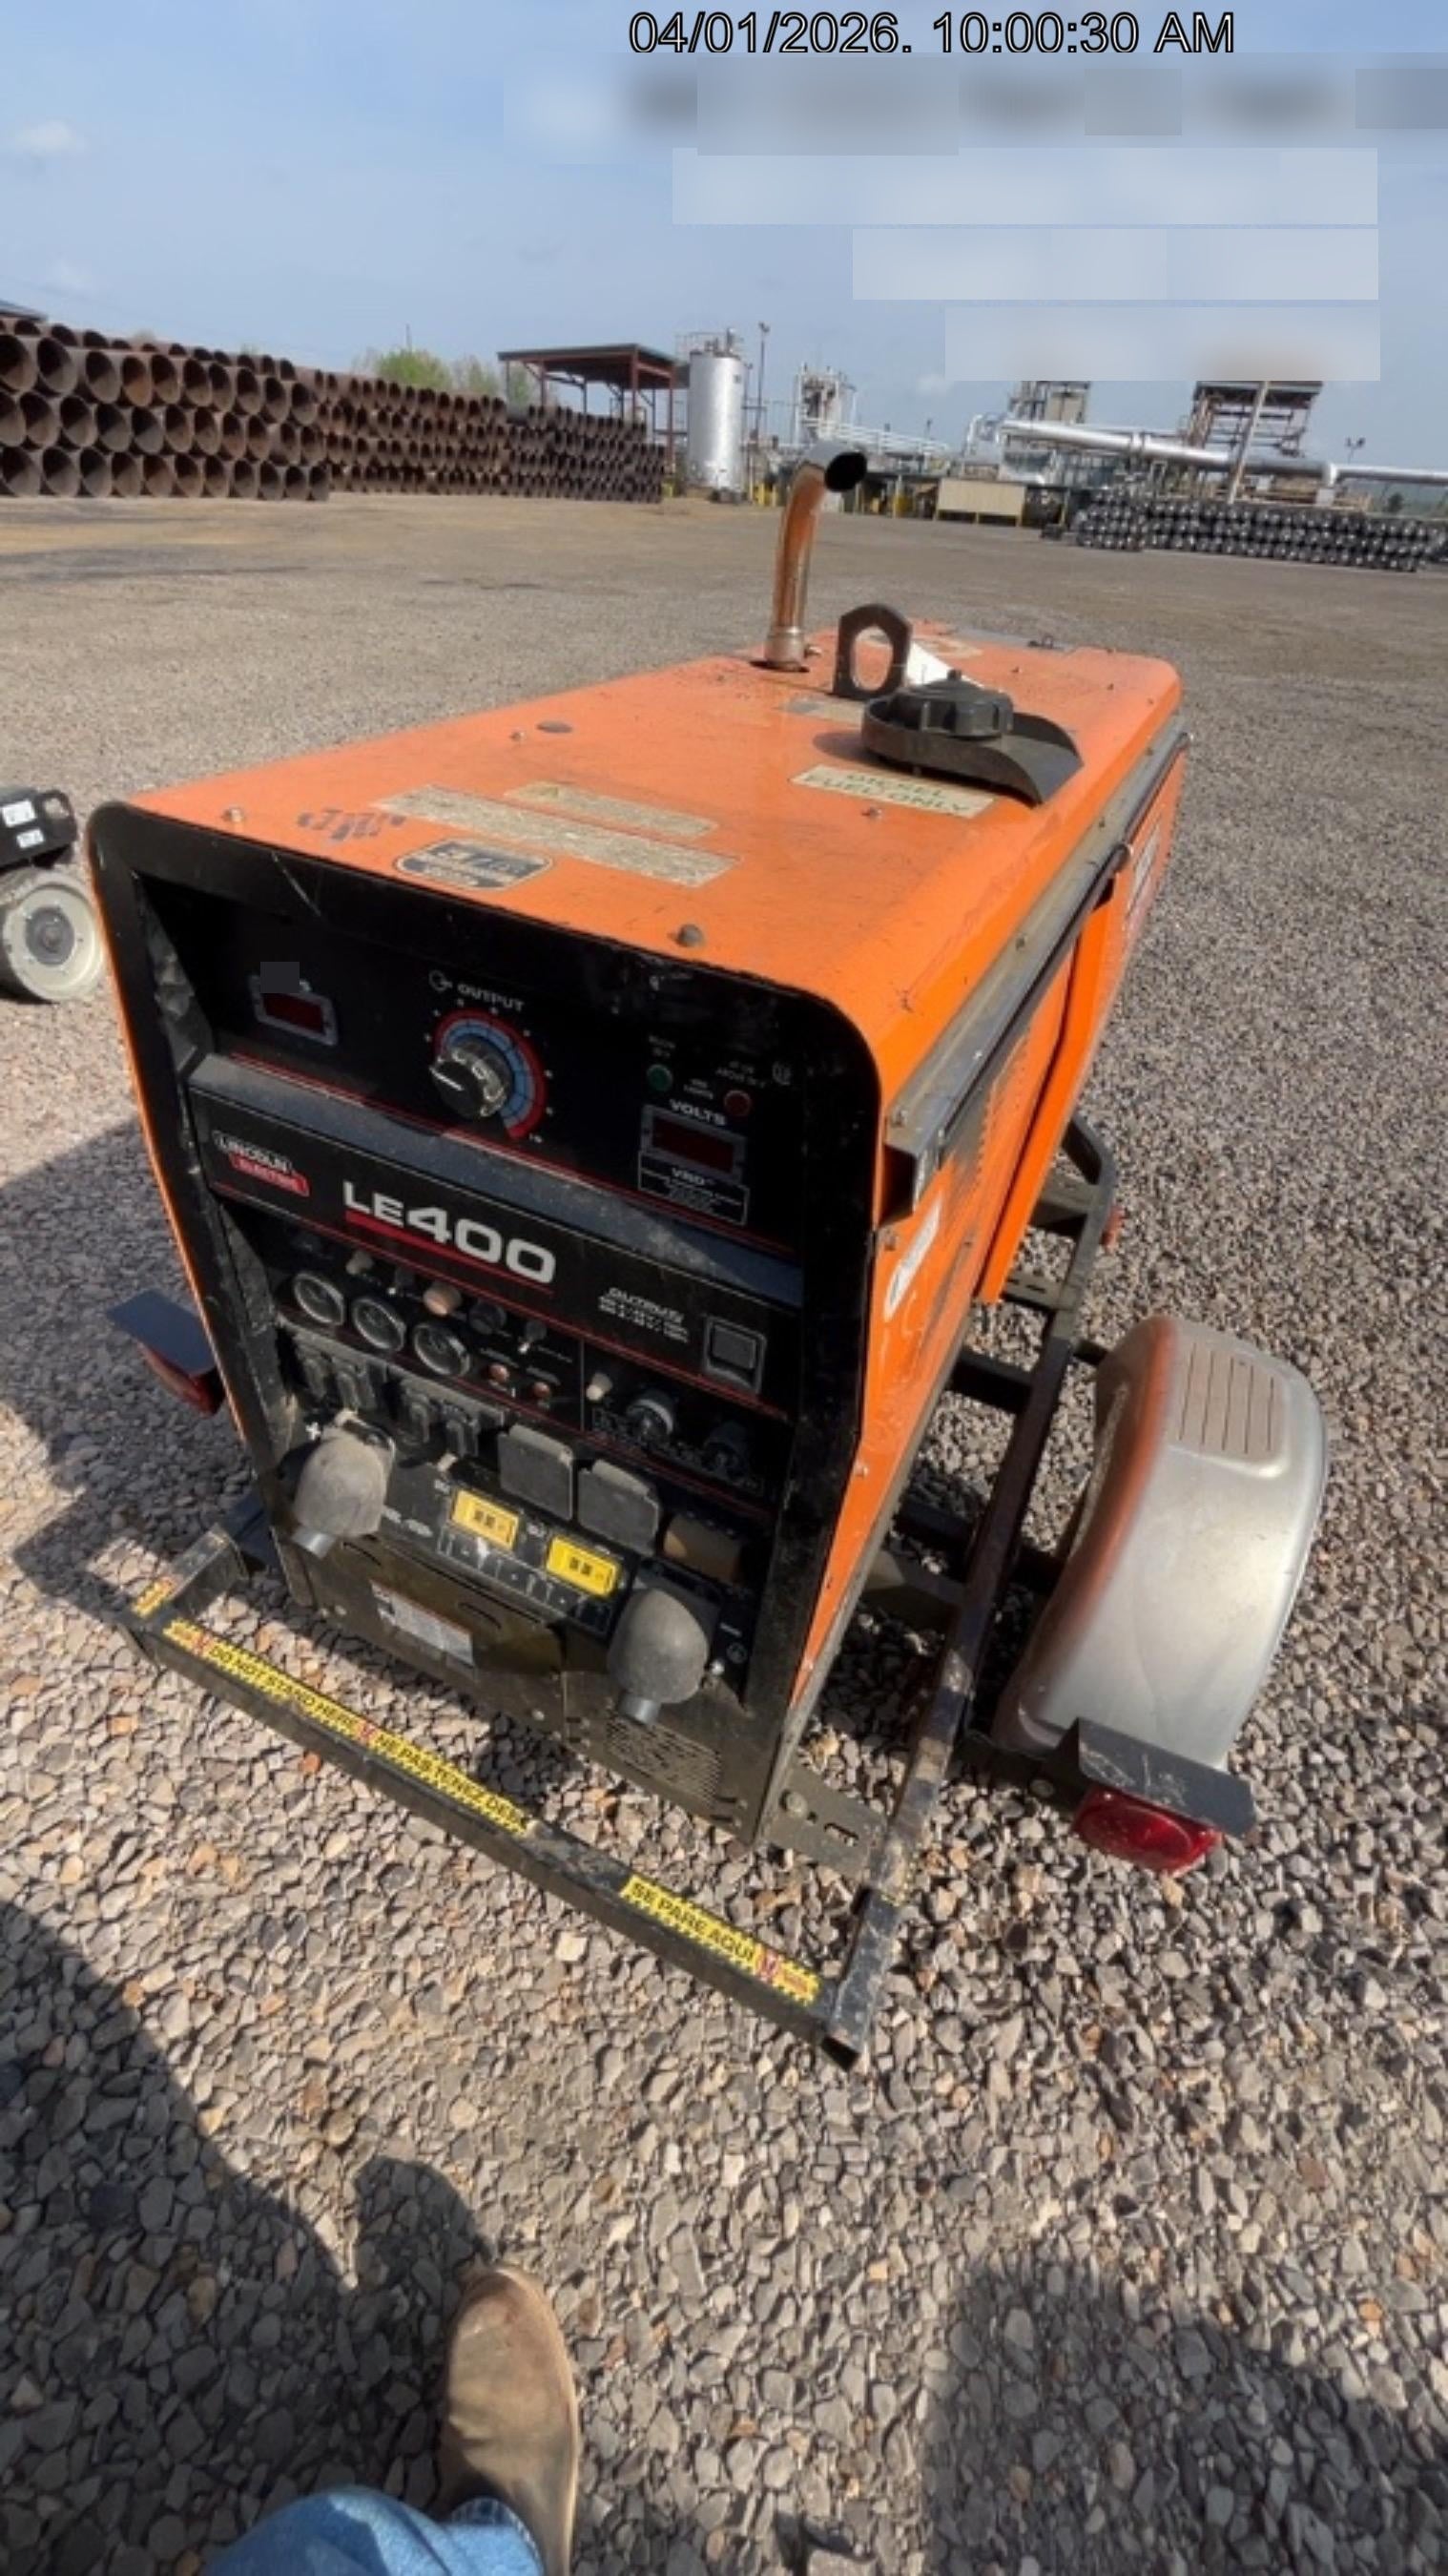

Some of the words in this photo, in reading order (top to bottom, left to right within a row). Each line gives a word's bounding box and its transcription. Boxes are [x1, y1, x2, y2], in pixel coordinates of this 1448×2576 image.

[845, 774, 946, 797] DIESEL
[456, 983, 525, 1011] OUTPUT
[669, 1098, 727, 1126] VOLTS
[219, 1135, 293, 1174] LINCOLN
[342, 1181, 557, 1284] LE400
[631, 1882, 657, 1904] SE
[657, 1899, 708, 1933] PARE
